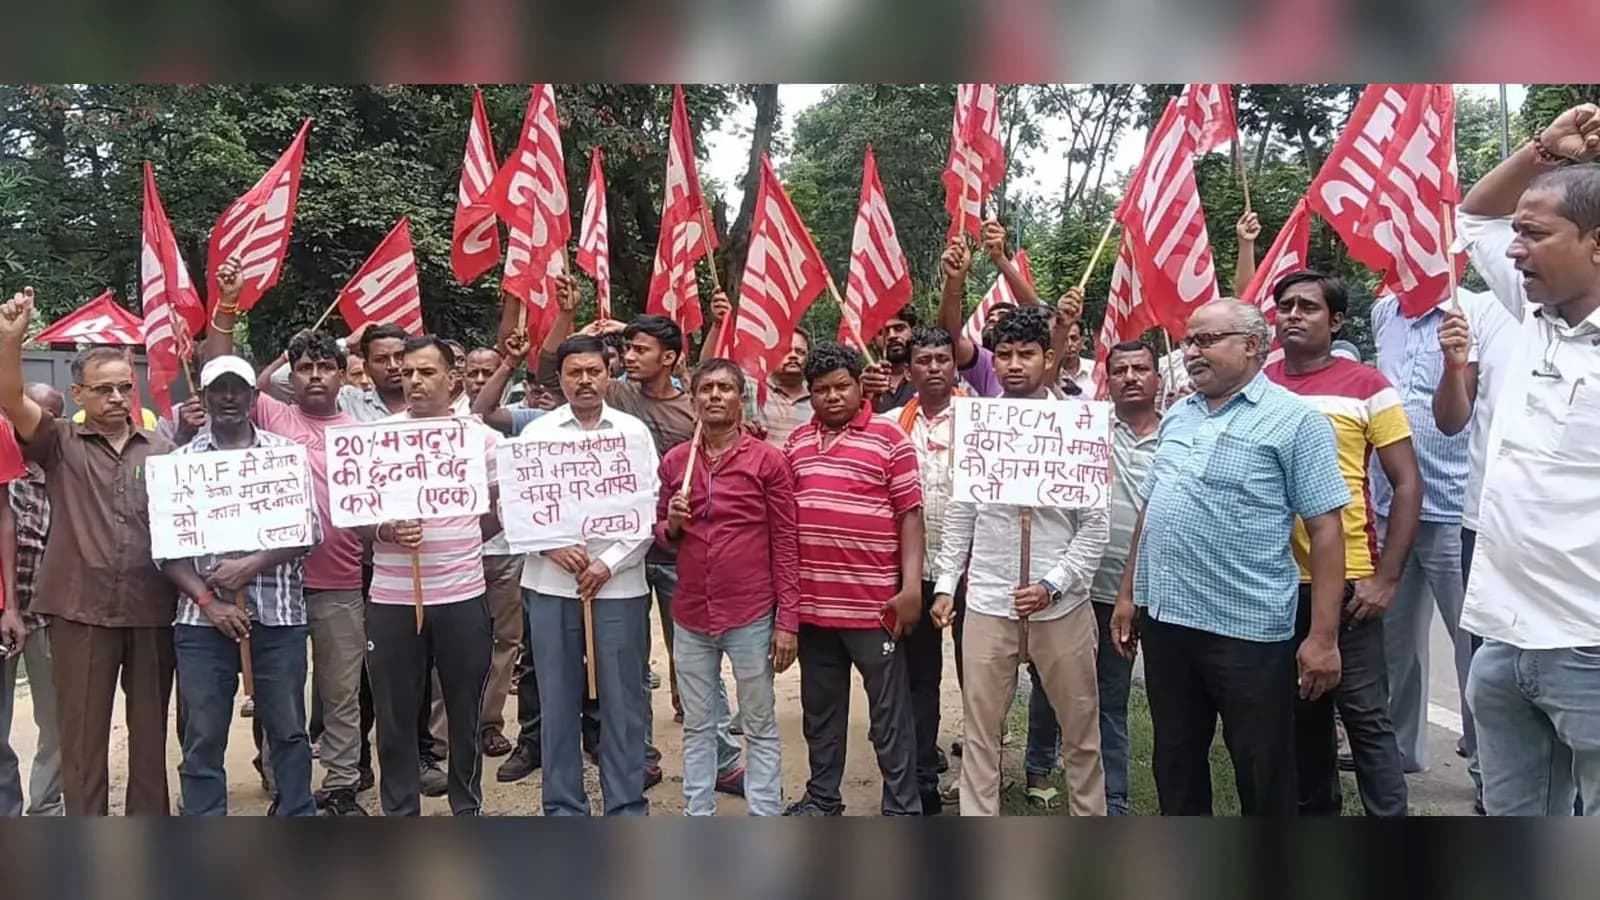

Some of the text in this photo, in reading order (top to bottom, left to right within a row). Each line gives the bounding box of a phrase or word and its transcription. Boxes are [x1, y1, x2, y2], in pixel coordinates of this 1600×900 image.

[332, 458, 362, 487] की
[609, 452, 631, 475] को
[1044, 460, 1069, 480] पर
[340, 485, 387, 517] करो
[569, 480, 595, 501] पर
[172, 505, 198, 528] को
